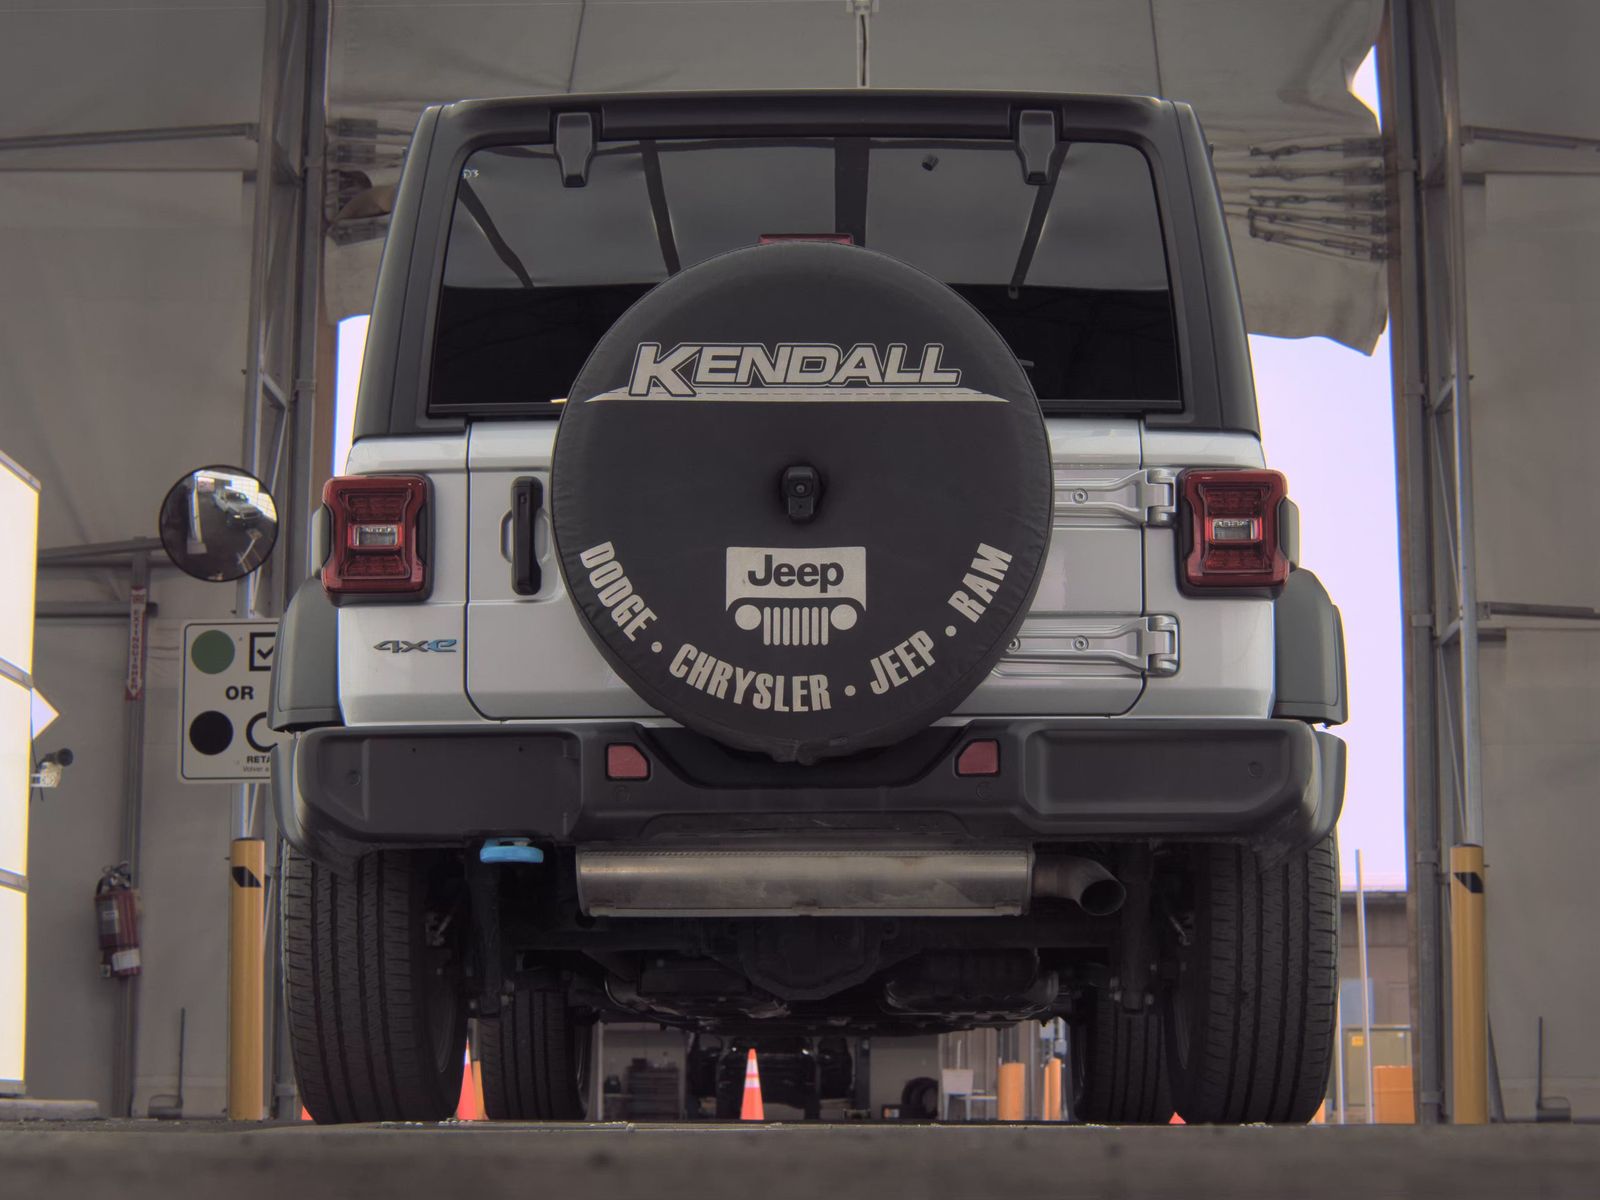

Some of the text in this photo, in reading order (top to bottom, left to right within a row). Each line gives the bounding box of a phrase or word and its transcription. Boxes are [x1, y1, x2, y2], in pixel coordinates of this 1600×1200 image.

[628, 342, 963, 397] KENDALL
[747, 554, 845, 593] Jeep
[579, 541, 1014, 712] DODGE CHRYSLER JEEP RAM
[225, 685, 254, 700] OR
